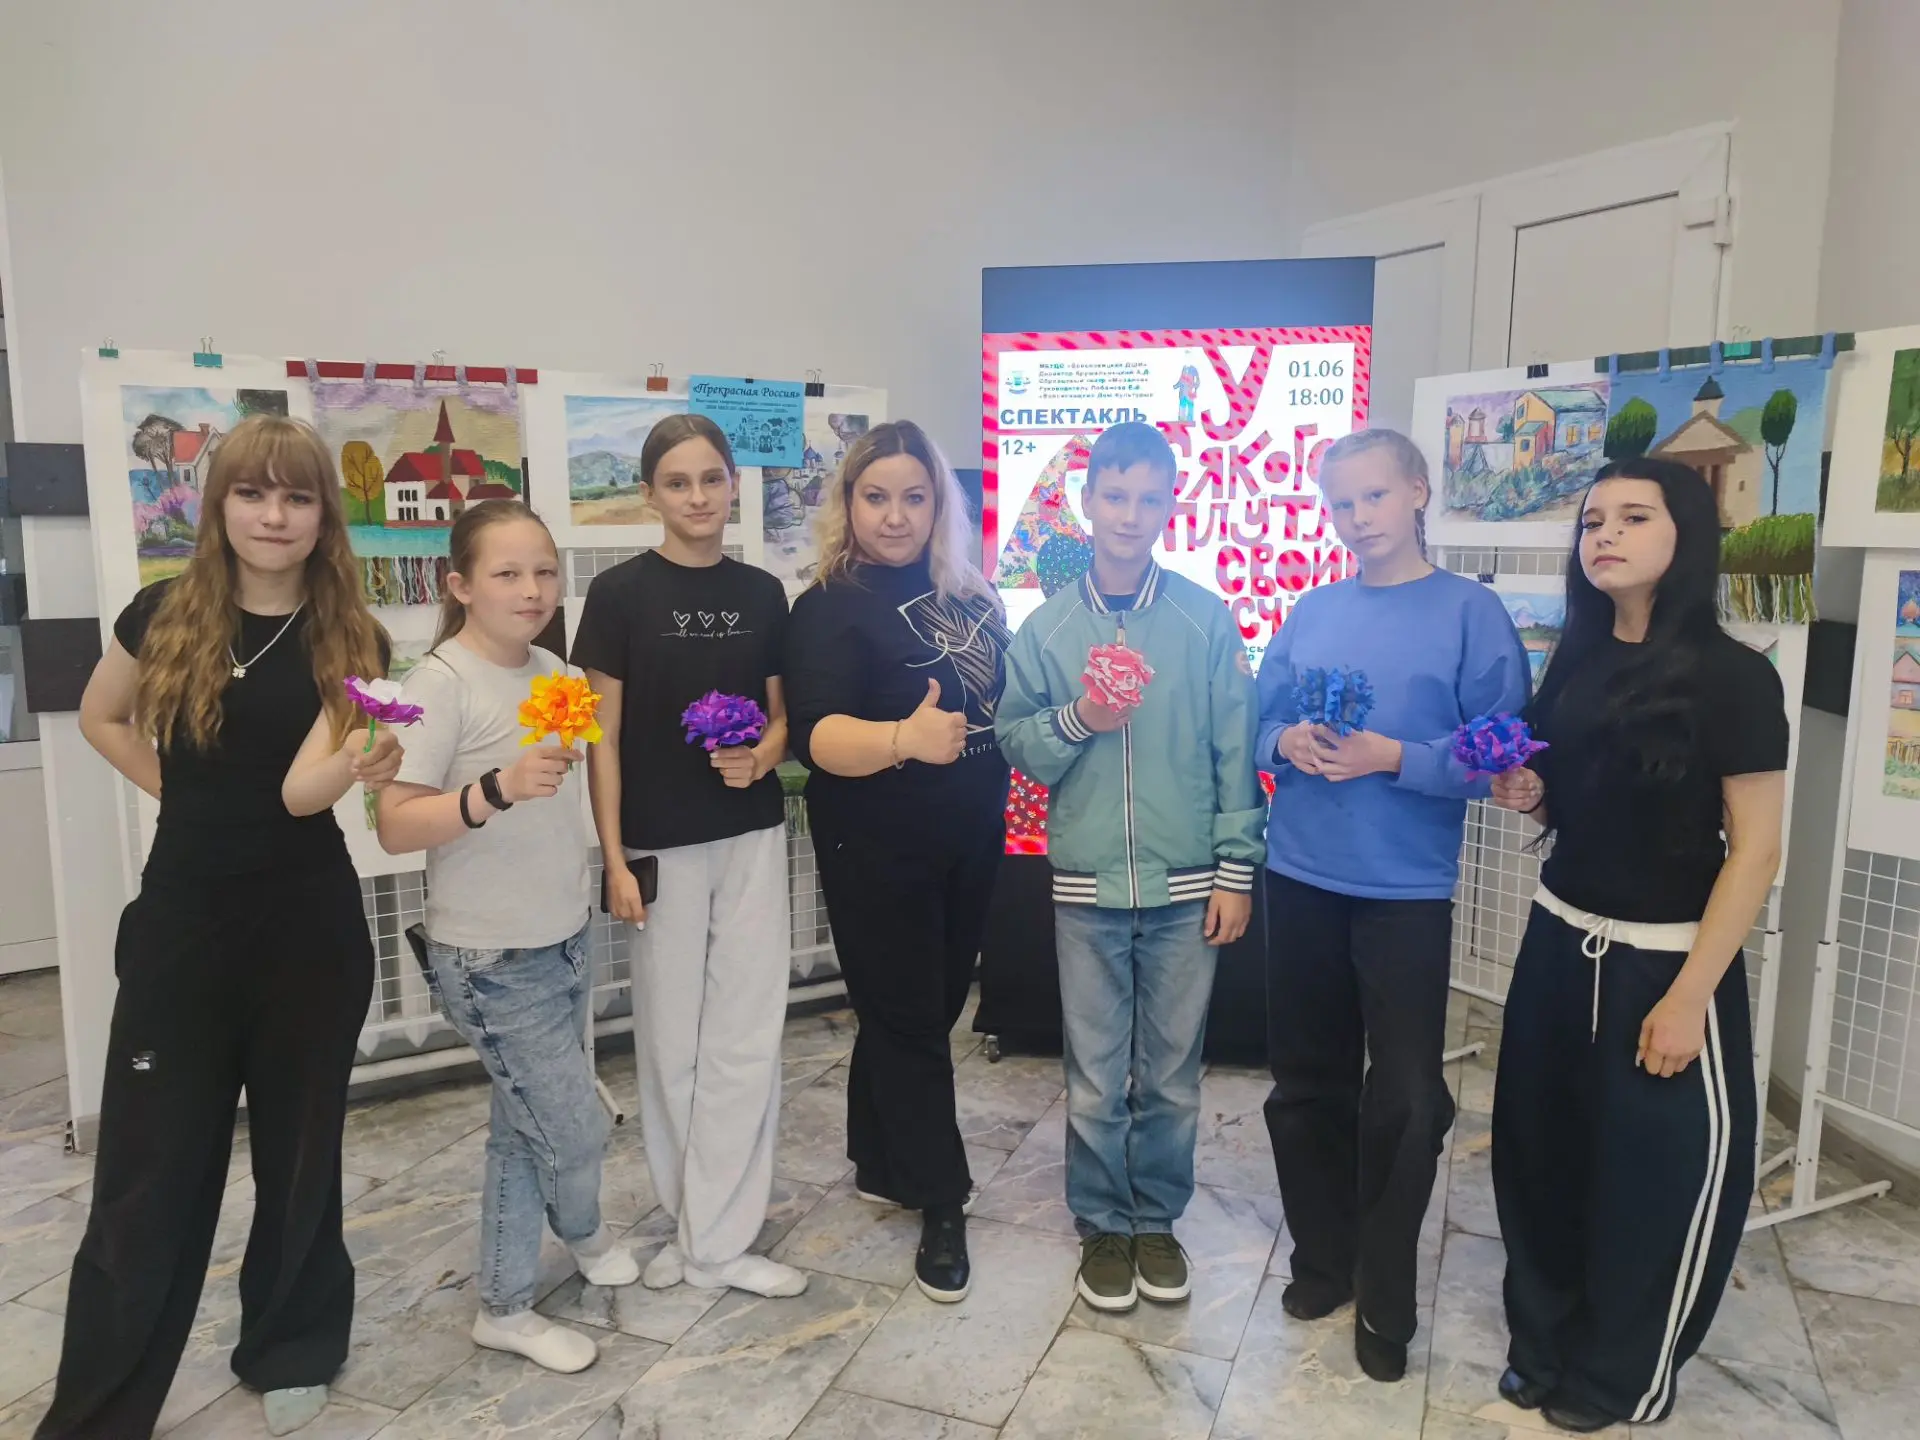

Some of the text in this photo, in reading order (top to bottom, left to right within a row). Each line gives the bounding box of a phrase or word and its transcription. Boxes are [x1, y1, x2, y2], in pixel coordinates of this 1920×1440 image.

[1288, 360, 1344, 378] 01.06
[693, 384, 800, 398] «Прекрасная Россия»
[1288, 388, 1344, 406] 18:00
[1000, 407, 1148, 425] СПЕКТАКЛЬ
[1002, 439, 1037, 456] 12+
[961, 743, 992, 758] STETI
